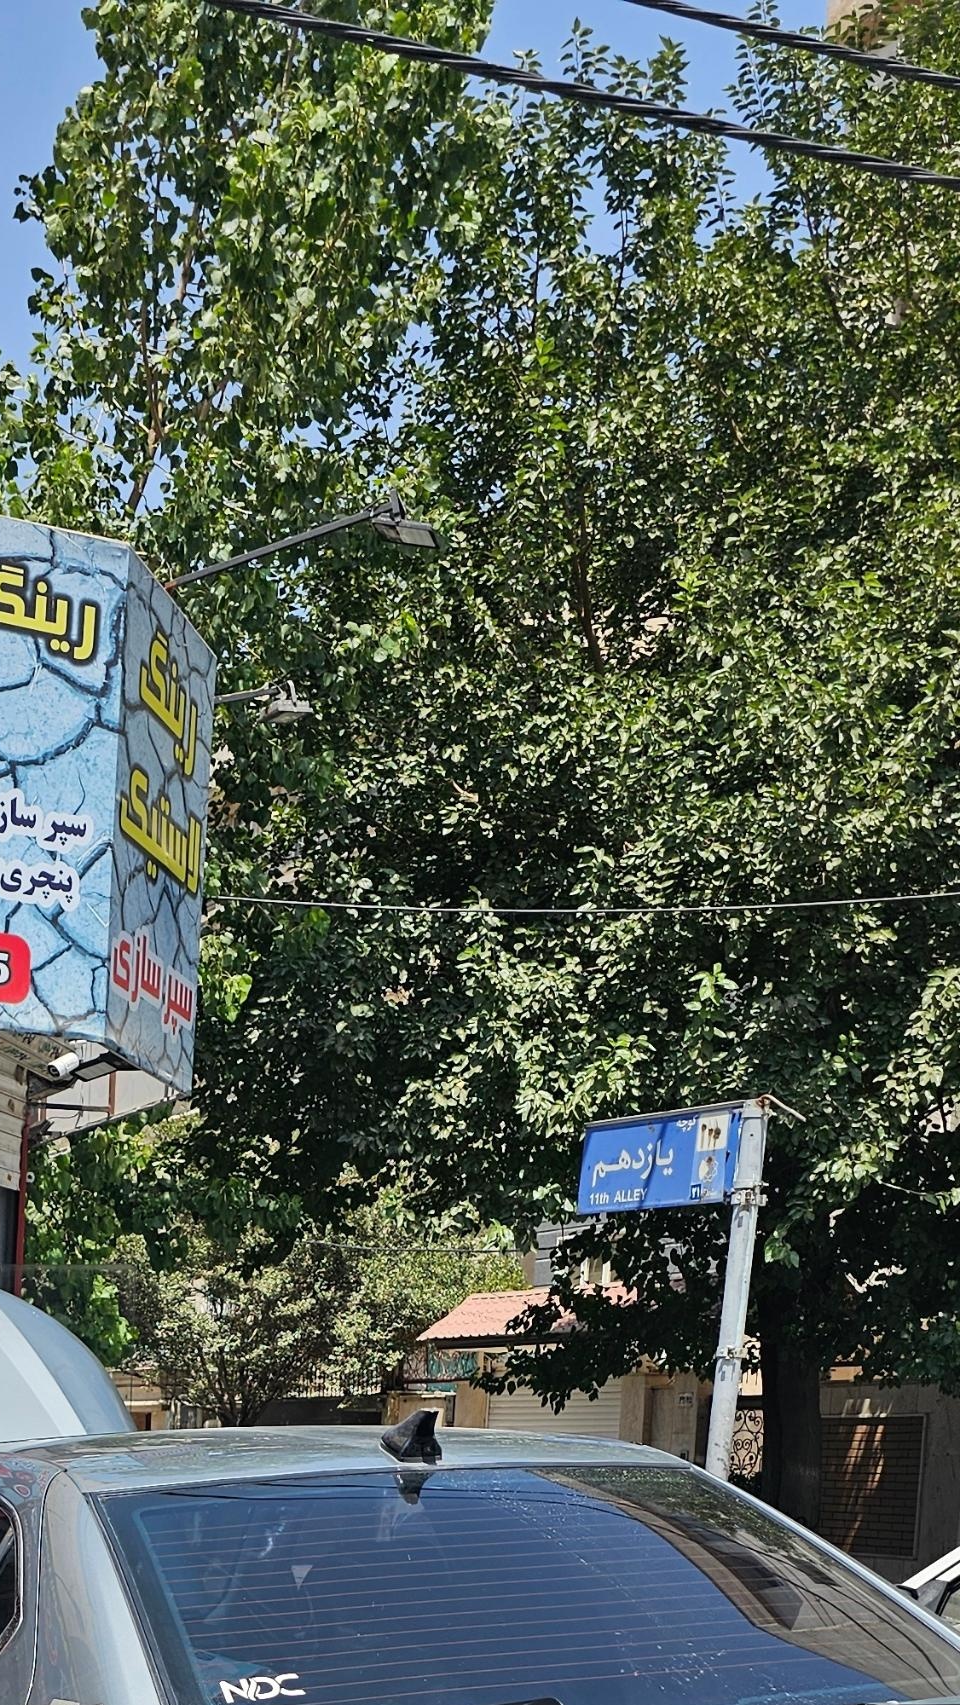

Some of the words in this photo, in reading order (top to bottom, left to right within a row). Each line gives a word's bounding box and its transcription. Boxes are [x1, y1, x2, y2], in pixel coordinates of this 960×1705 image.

[140, 630, 198, 777] رینگ
[120, 768, 202, 895] لاستیک
[675, 1115, 699, 1133] کوچه
[591, 1139, 675, 1188] یازدهم
[589, 1191, 610, 1206] 11th
[613, 1187, 649, 1204] ALLEY
[219, 1672, 307, 1704] NDC
